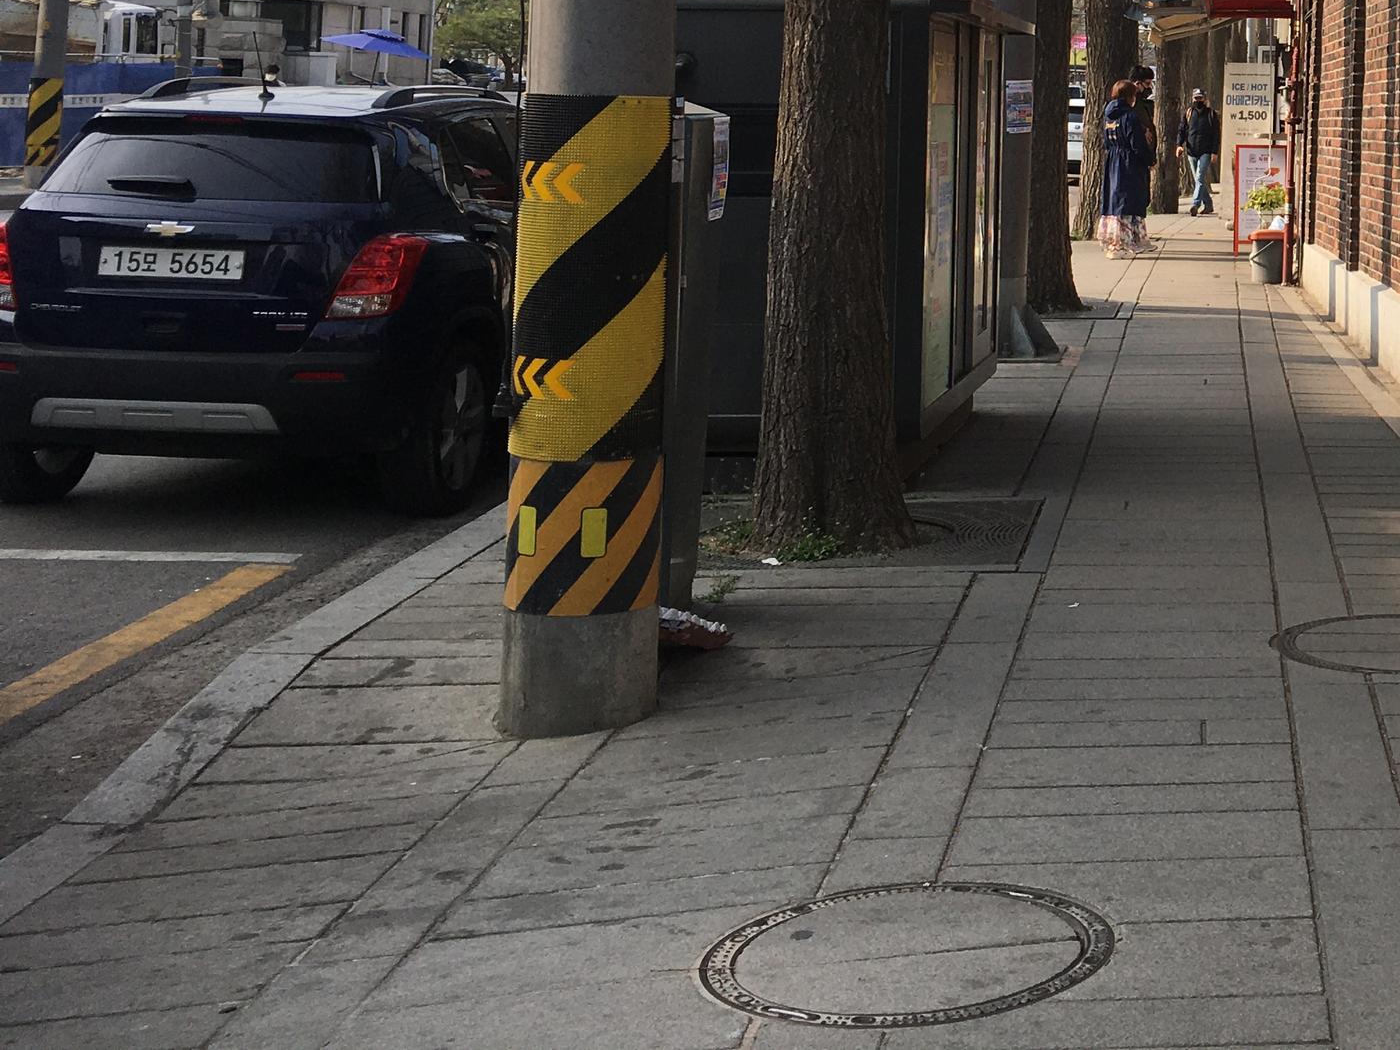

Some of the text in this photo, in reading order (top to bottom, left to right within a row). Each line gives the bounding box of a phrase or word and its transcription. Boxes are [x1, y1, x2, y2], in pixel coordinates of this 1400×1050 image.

[1231, 83, 1245, 91] ICE
[1250, 83, 1268, 91] HOT
[1226, 94, 1271, 106] 아메리카노
[1238, 110, 1267, 122] 1,500
[113, 251, 230, 276] 15모 5654
